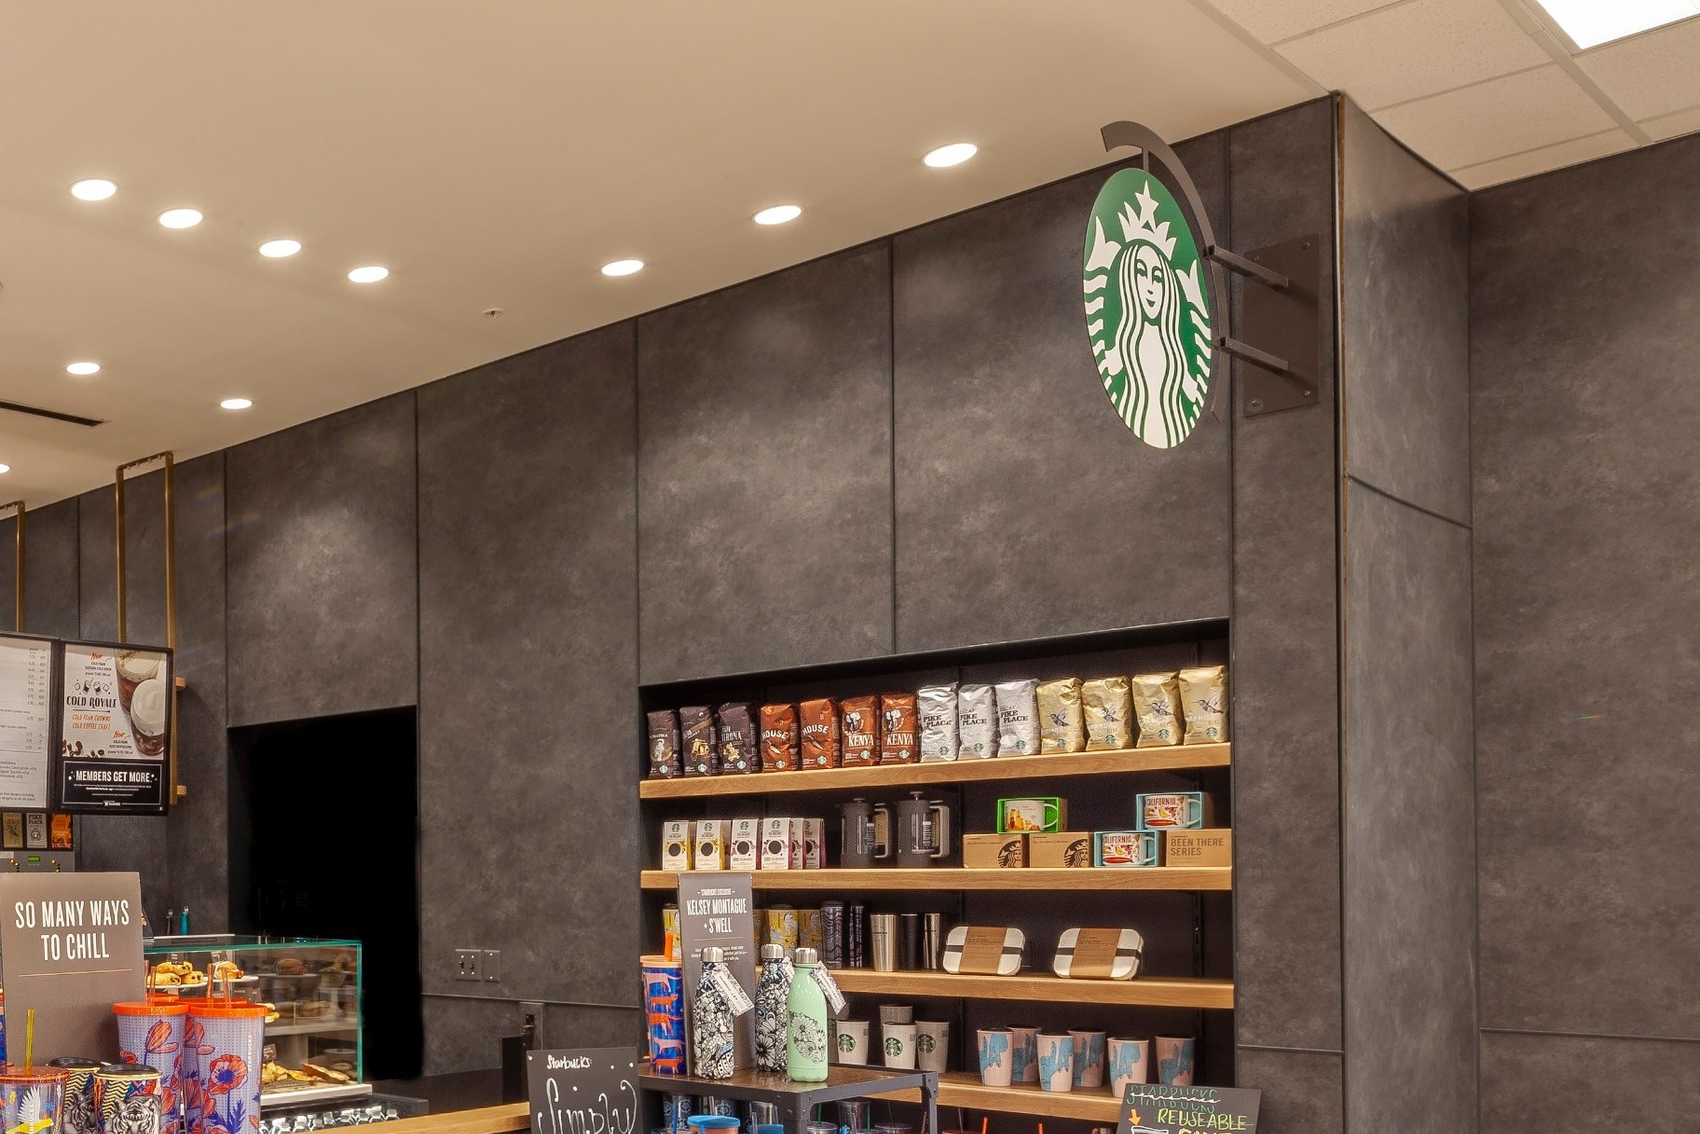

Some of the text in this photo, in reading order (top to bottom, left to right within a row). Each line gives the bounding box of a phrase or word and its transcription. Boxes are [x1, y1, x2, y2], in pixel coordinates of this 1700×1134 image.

[67, 696, 117, 708] COLD ROYALE
[1001, 710, 1018, 718] PIKE
[762, 730, 788, 740] HOUSE
[802, 725, 829, 736] HOUSE
[849, 735, 873, 746] KENYA
[887, 733, 913, 745] KENYA
[76, 771, 111, 781] MEMBERS
[114, 771, 127, 782] GET
[1171, 838, 1224, 846] BEEN THERE
[687, 899, 747, 915] KELSEY MONTAGUE
[15, 900, 130, 928] SO MANY WAYS
[41, 933, 109, 960] TO CHILL
[1127, 1085, 1218, 1113] STARBUCKS
[1158, 1108, 1247, 1131] REUSEABLE
